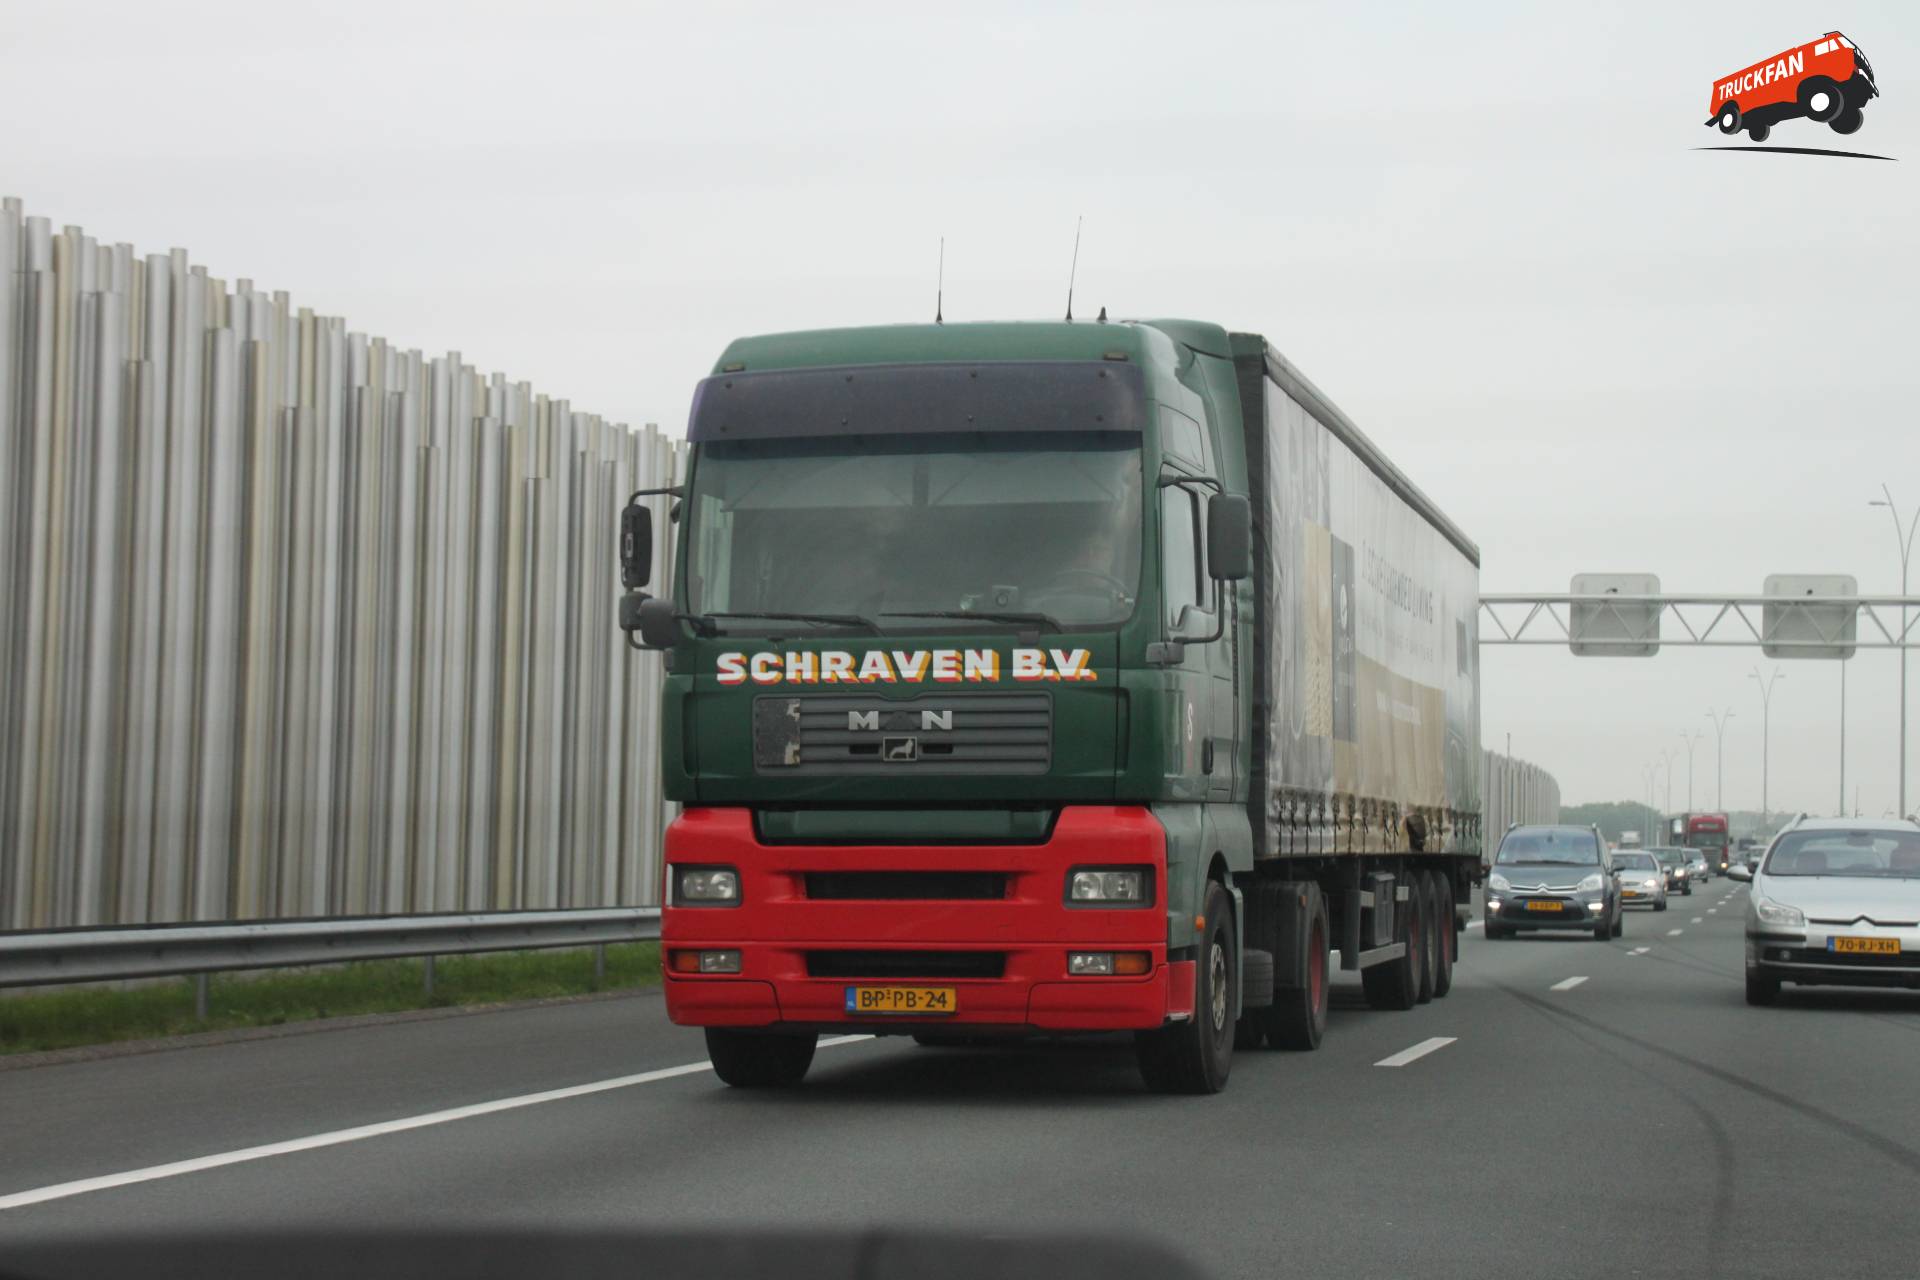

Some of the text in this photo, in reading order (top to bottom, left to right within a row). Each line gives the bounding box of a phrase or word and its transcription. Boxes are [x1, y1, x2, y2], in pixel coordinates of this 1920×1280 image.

[716, 648, 1098, 685] SCHRAVEN B.V.
[848, 710, 953, 730] MN
[861, 989, 948, 1008] BP-PB-24
